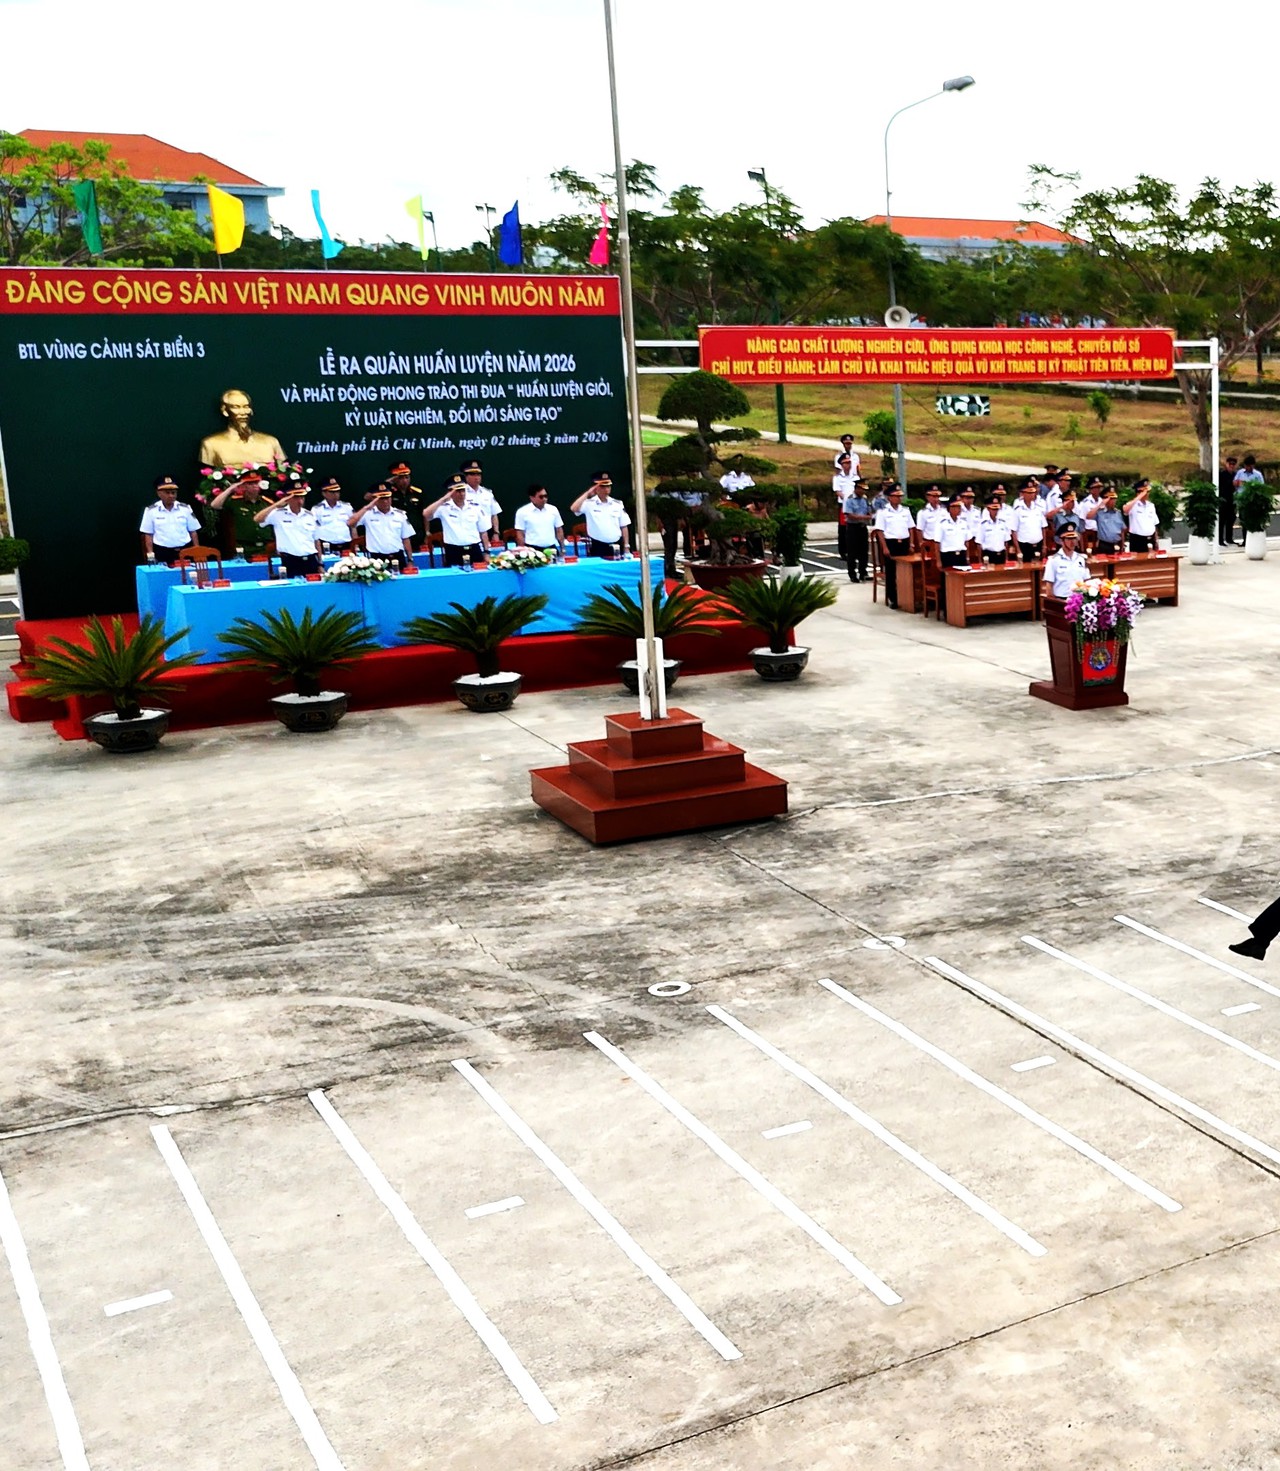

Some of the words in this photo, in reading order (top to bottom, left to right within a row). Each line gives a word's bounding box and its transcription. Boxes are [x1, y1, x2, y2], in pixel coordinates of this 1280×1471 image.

[5, 272, 86, 304] ĐẢNG
[92, 275, 173, 309] CỘNG
[179, 274, 228, 304] SẢN
[233, 277, 279, 309] VIỆT
[286, 282, 341, 305] NAM
[346, 283, 430, 306] QUANG
[434, 285, 484, 306] VINH
[491, 281, 556, 306] MUÔN
[559, 281, 605, 306] NĂM
[18, 343, 41, 359] BTL
[44, 338, 87, 359] VÙNG
[90, 337, 133, 359] CẢNH
[135, 338, 160, 358] SÁT
[163, 335, 194, 358] BIỂN
[197, 343, 205, 358] 3
[747, 336, 777, 353] NÂNG
[780, 339, 800, 353] CAO
[803, 335, 829, 353] CHẤT
[831, 338, 864, 356] LƯỢNG
[866, 337, 902, 353] NGHIÊN
[929, 338, 949, 353] ỨNG
[951, 340, 977, 356] DỤNG
[978, 340, 1003, 353] KHOA
[1005, 340, 1023, 356] HỌC
[1025, 338, 1049, 353] CÔNG
[1078, 335, 1111, 353] CHUYỂN
[1113, 335, 1127, 353] ĐỔI
[1129, 336, 1140, 353] SỐ
[319, 347, 336, 375] LỄ
[339, 356, 362, 375] RA
[364, 351, 411, 375] QUÂN
[414, 348, 456, 375] HUẤN
[460, 350, 504, 377] LUYỆN
[506, 350, 541, 373] NĂM
[544, 354, 576, 372] 2026
[733, 360, 755, 375] HUY,
[818, 358, 839, 374] LÀM
[842, 356, 862, 374] CHỦ
[865, 358, 878, 373] VÀ
[880, 360, 903, 374] KHAI
[905, 358, 929, 374] THÁC
[932, 358, 953, 377] HIỆU
[955, 356, 974, 375] QUẢ
[990, 358, 1005, 373] KHÍ
[1007, 359, 1035, 373] TRANG
[1037, 360, 1047, 376] BỊ
[1062, 357, 1088, 375] THUẬT
[1090, 357, 1108, 372] TIÊN
[1133, 357, 1151, 374] HIỆN
[1153, 359, 1167, 374] ĐẠI
[280, 383, 301, 402] VÀ
[303, 383, 335, 402] PHÁT
[338, 383, 377, 405] ĐỘNG
[380, 386, 425, 401] PHONG
[427, 381, 459, 400] TRÀO
[461, 385, 478, 399] THI
[481, 384, 506, 399] ĐUA
[516, 378, 548, 397] HUẤN
[551, 379, 583, 399] LUYỆN
[586, 376, 614, 397] GIỎI,
[364, 408, 392, 429] LUẬT
[395, 407, 446, 426] NGHIÊM,
[449, 402, 471, 423] ĐỔI
[474, 404, 498, 423] MỚI
[500, 404, 532, 422] SÁNG
[296, 441, 339, 454] Thành
[342, 436, 367, 455] phố
[371, 436, 390, 451] Hồ
[393, 438, 415, 450] Chí
[419, 436, 455, 450] Minh,
[459, 435, 488, 450] ngày
[491, 435, 505, 447] 02
[508, 434, 541, 448] tháng
[544, 434, 551, 446] 3
[554, 432, 579, 444] năm
[582, 431, 608, 443] 2026
